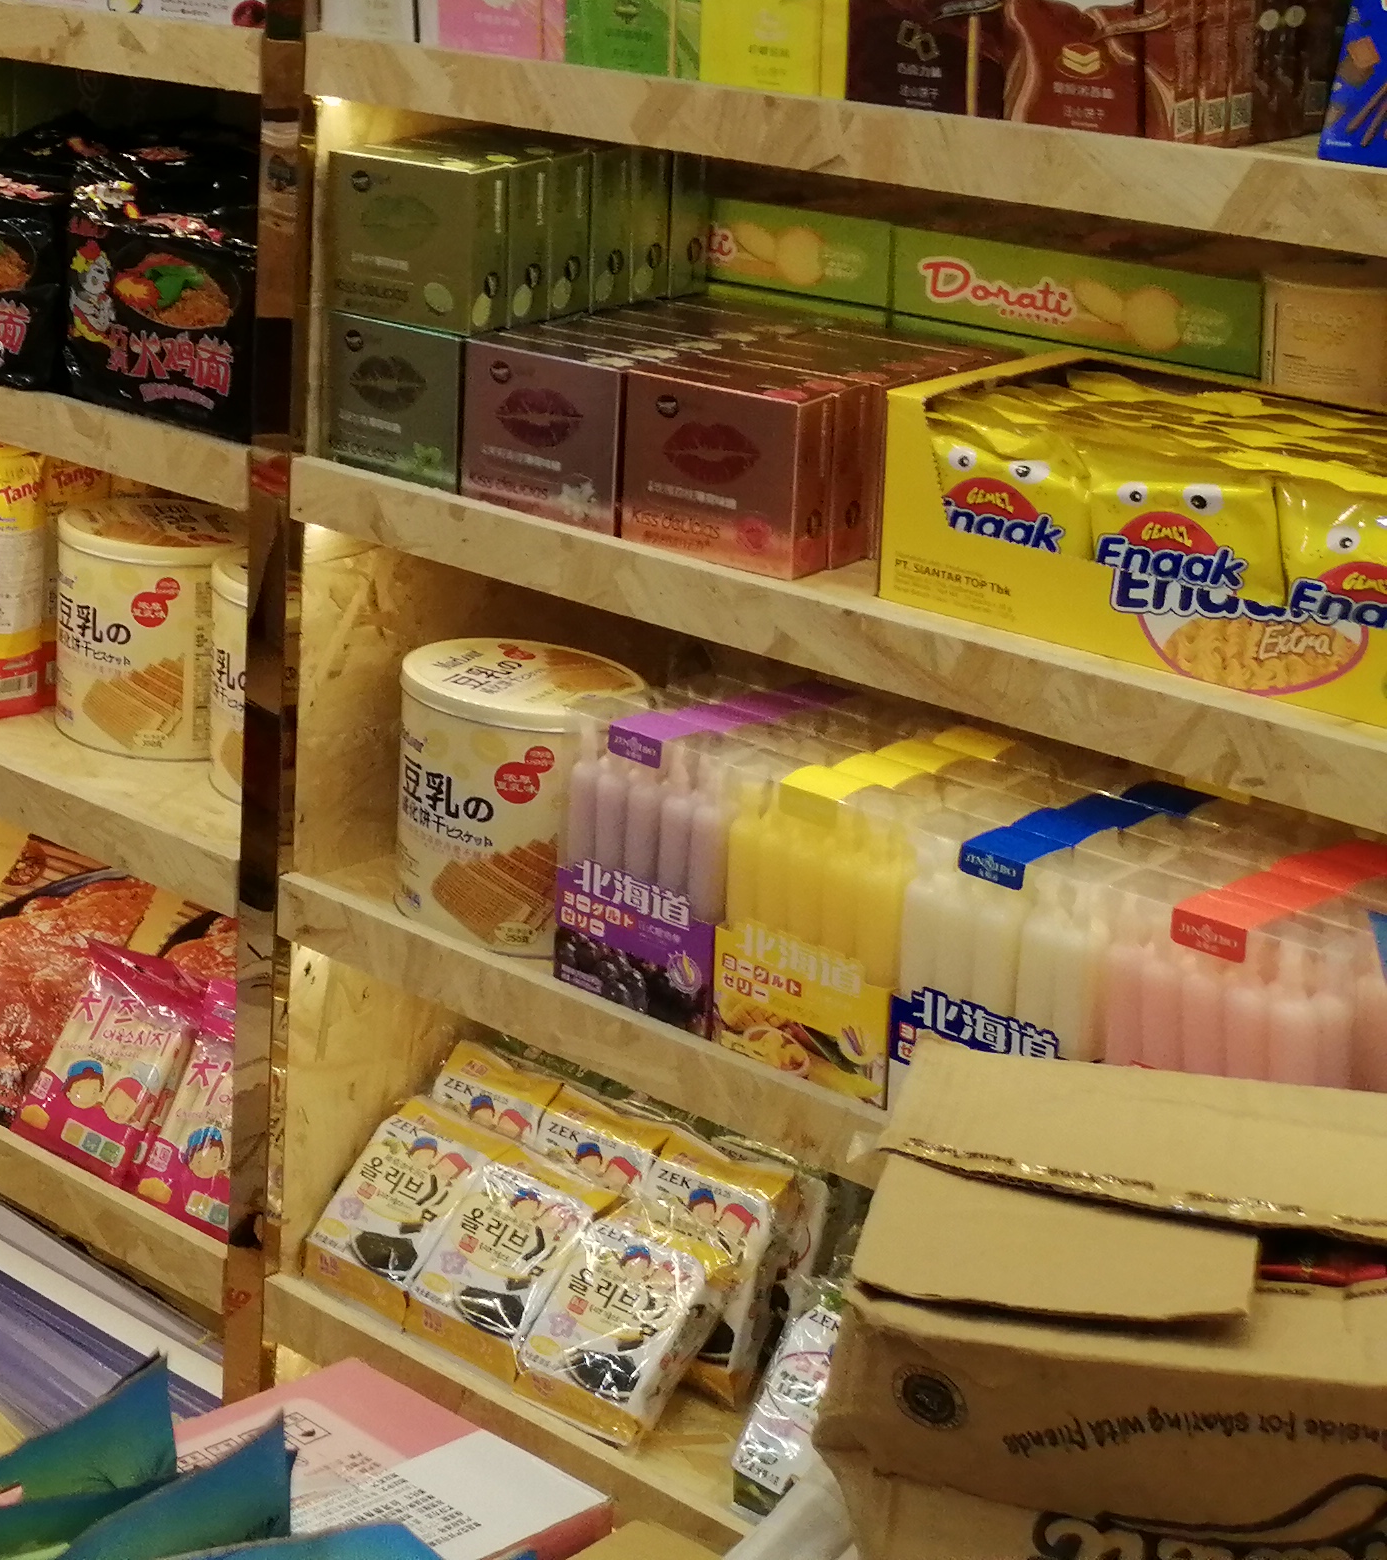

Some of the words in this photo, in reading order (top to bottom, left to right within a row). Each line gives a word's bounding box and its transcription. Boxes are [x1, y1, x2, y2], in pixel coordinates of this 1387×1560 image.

[921, 259, 1075, 322] Dorati
[131, 331, 233, 396] 火鸡面
[941, 494, 1066, 554] naak
[966, 485, 1013, 514] GEMEZ
[1141, 521, 1193, 548] GEMEZ
[914, 561, 962, 585] SIANTAR
[964, 573, 989, 589] TOP
[990, 578, 1012, 597] Tbk
[1094, 533, 1250, 591] Enaak
[59, 592, 132, 646] 豆乳の
[1253, 624, 1333, 660] Extra
[402, 753, 495, 824] 豆乳の
[562, 891, 634, 930] ヨーグルト
[573, 859, 691, 931] 北海道
[721, 952, 803, 998] ヨーグルト
[735, 922, 861, 997] 北海道
[912, 986, 1060, 1060] 北海道
[442, 1075, 476, 1098] ZEK
[547, 1120, 581, 1142] ZEK
[358, 1154, 423, 1204] 올리브
[658, 1166, 694, 1190] ZEK
[461, 1204, 527, 1255] 올리브
[568, 1262, 638, 1314] 올리브
[1002, 1414, 1085, 1458] friends
[1086, 1415, 1146, 1448] with
[1146, 1406, 1250, 1437] sharing
[1258, 1409, 1297, 1440] for
